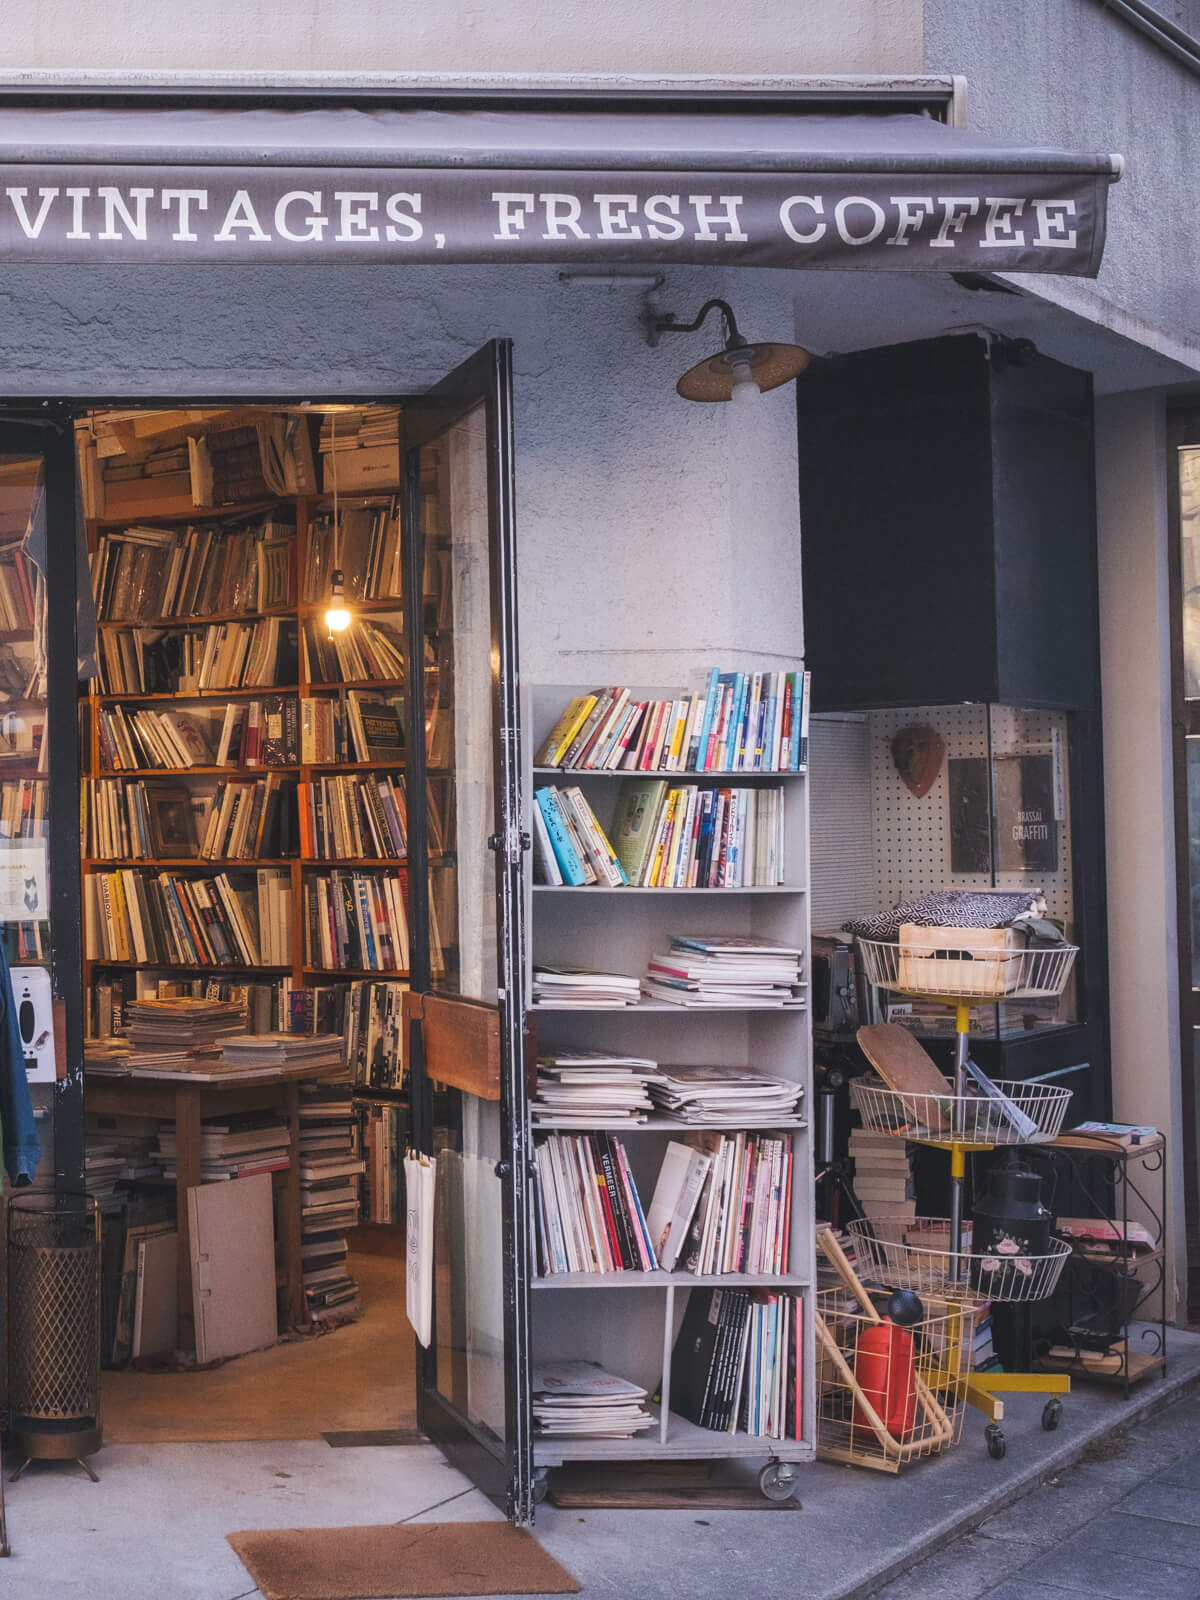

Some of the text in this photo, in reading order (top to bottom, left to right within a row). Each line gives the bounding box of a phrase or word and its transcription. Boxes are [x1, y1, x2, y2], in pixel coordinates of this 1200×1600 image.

[6, 187, 448, 250] VINTAGES,
[492, 192, 749, 243] FRESH
[778, 194, 1079, 250] COFFEE
[1012, 825, 1048, 841] GRAFFITI
[601, 1153, 617, 1198] VERMEER
